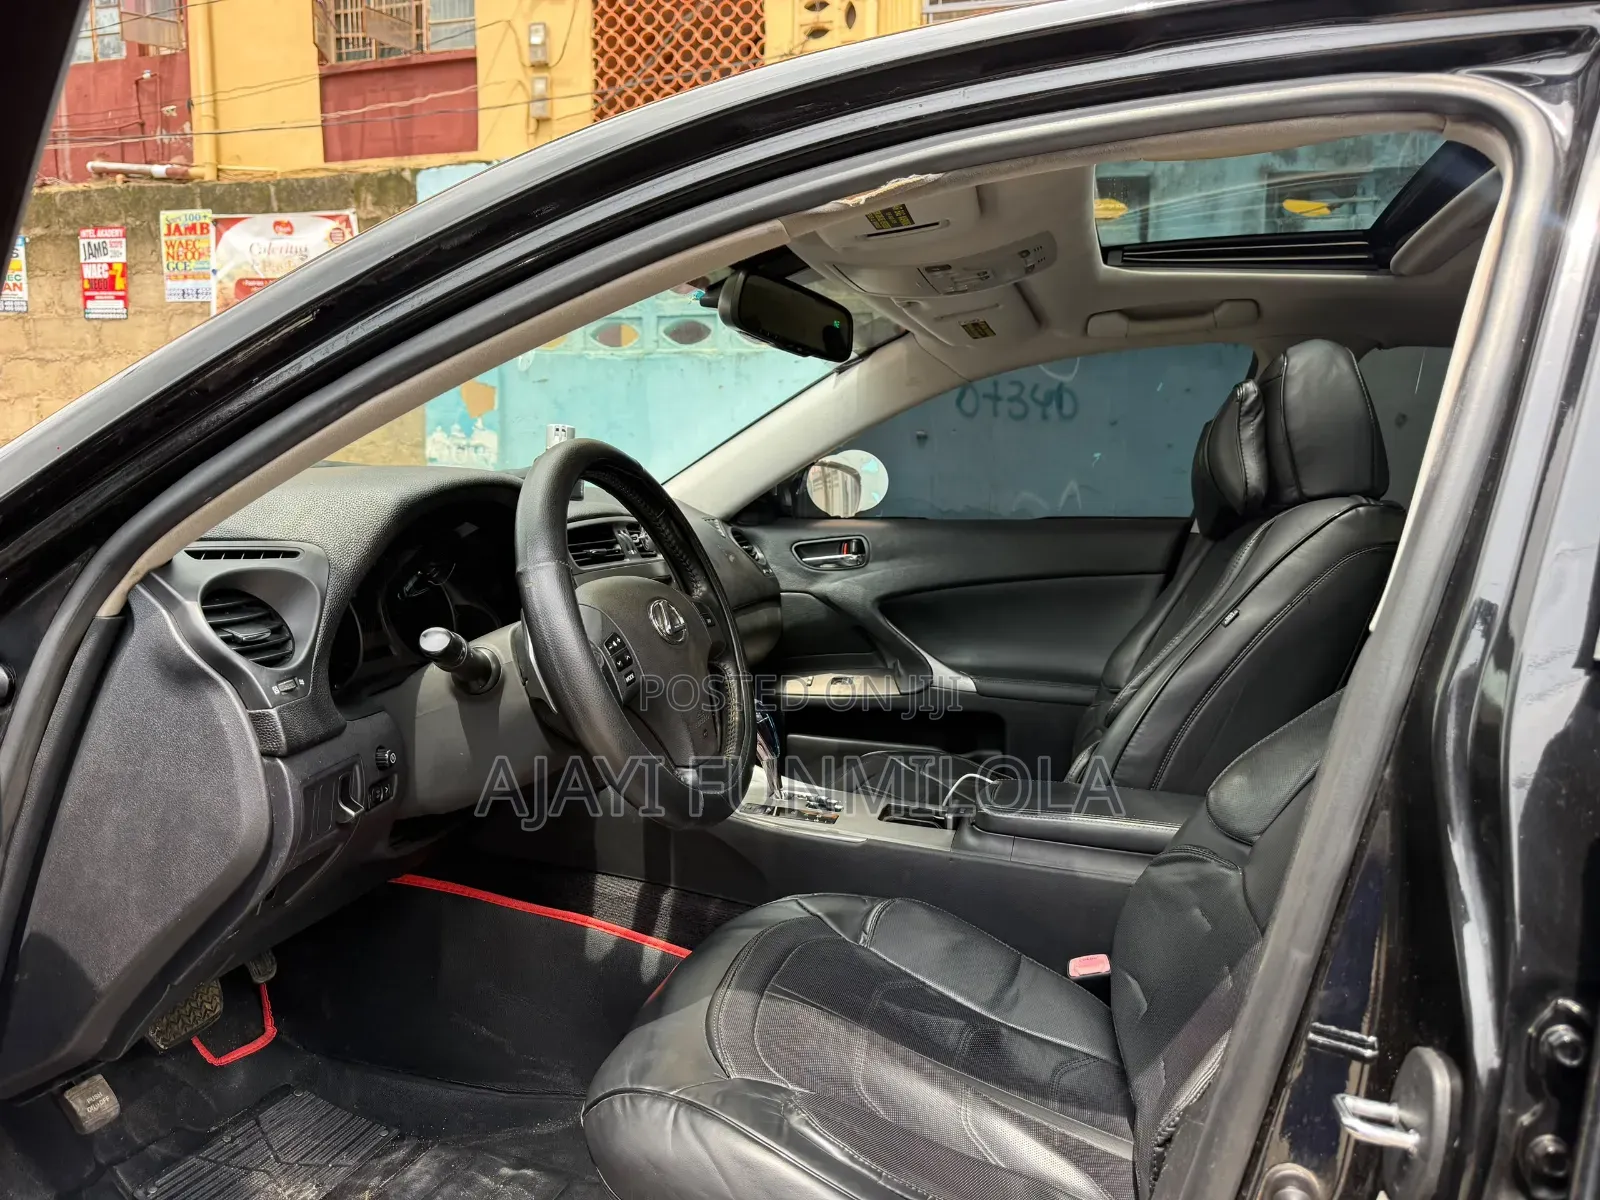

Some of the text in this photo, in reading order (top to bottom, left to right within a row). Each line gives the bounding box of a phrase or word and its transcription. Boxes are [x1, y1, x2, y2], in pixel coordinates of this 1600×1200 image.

[164, 222, 210, 237] JAMB
[83, 241, 109, 261] JAMB
[165, 240, 201, 251] WAEC
[166, 250, 201, 262] NECO
[82, 263, 109, 279] WAEC
[166, 261, 192, 272] GCE
[86, 1091, 103, 1105] PUSH
